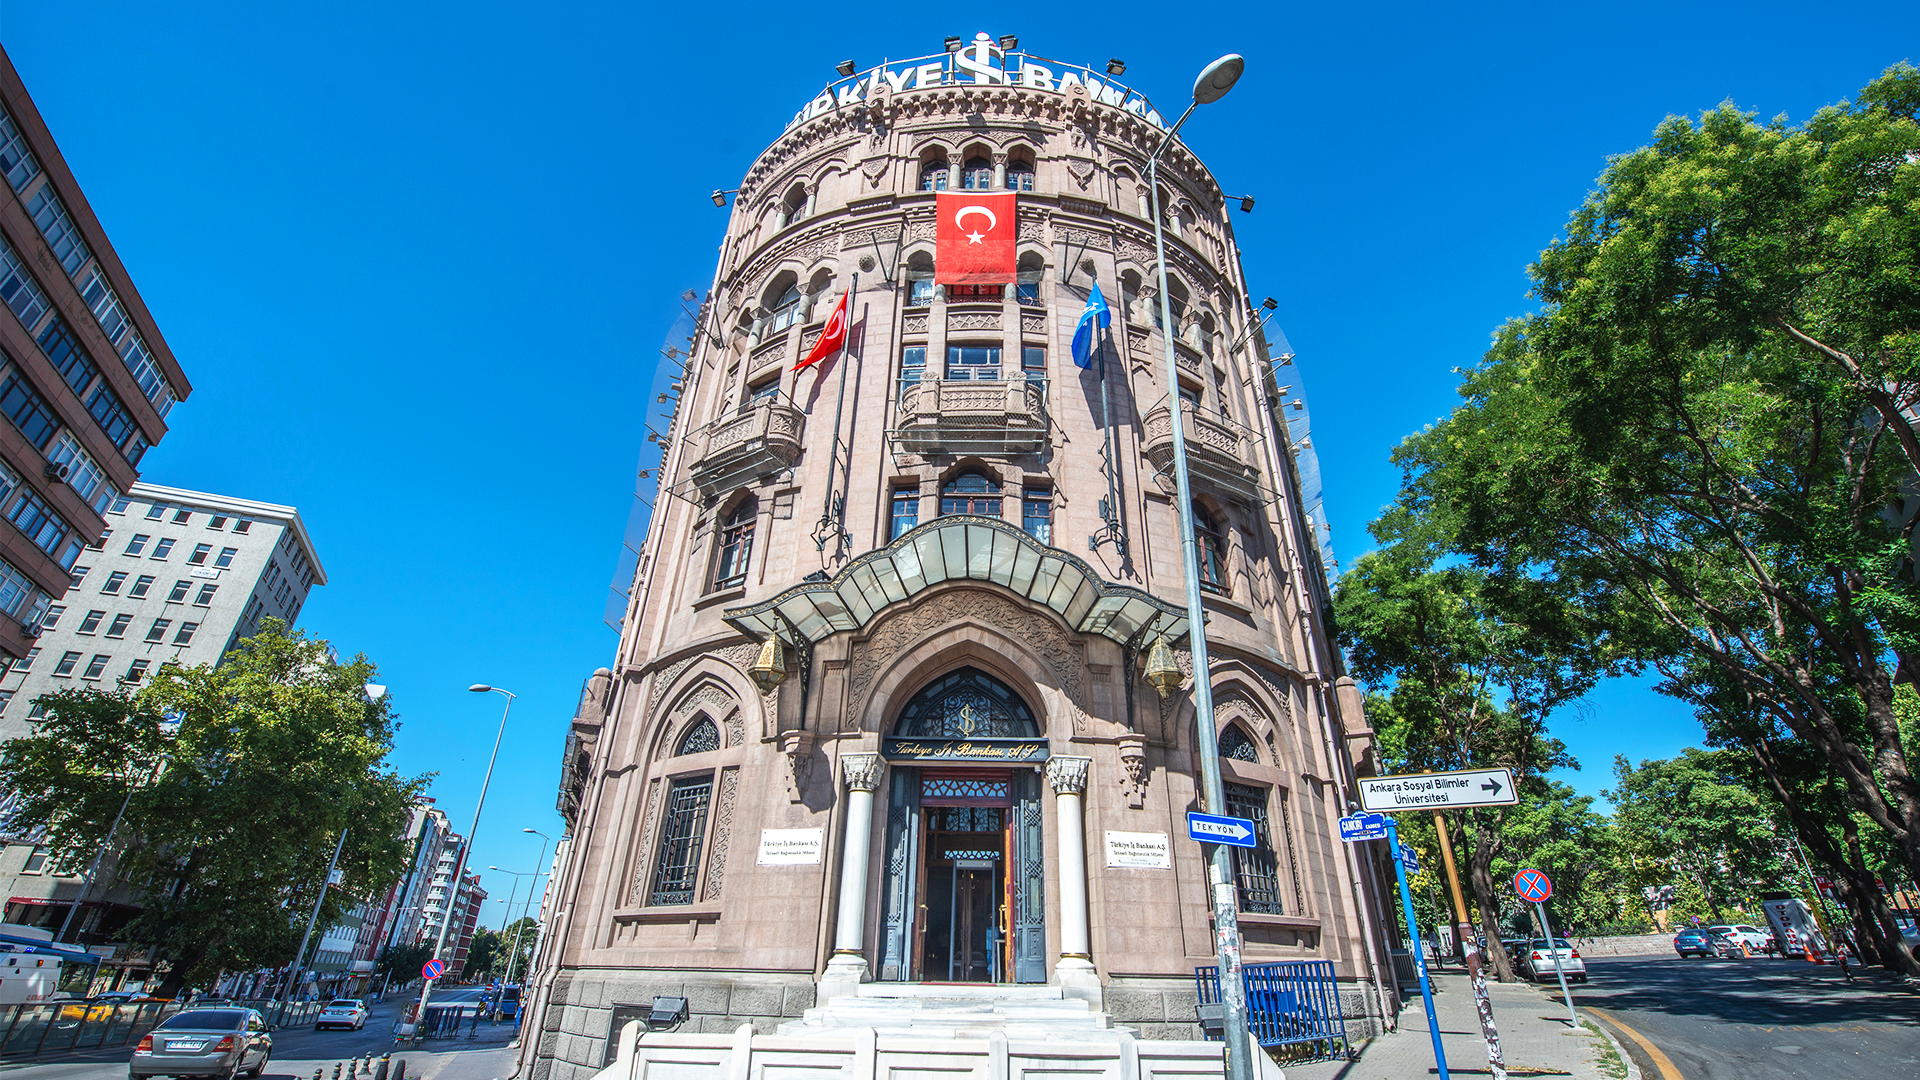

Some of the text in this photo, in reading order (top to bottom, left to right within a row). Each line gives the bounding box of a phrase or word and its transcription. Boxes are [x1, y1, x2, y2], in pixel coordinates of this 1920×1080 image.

[890, 742, 932, 757] Türkiye
[954, 742, 1005, 759] Bankası
[1369, 778, 1470, 793] Ankara Sosyal Bilimler
[1394, 792, 1450, 805] Üniversitesi
[1196, 822, 1234, 835] TEK YÖN
[1110, 841, 1130, 849] Türkiye
[1135, 842, 1156, 850] Bankası
[1775, 904, 1799, 946] OTOPARK
